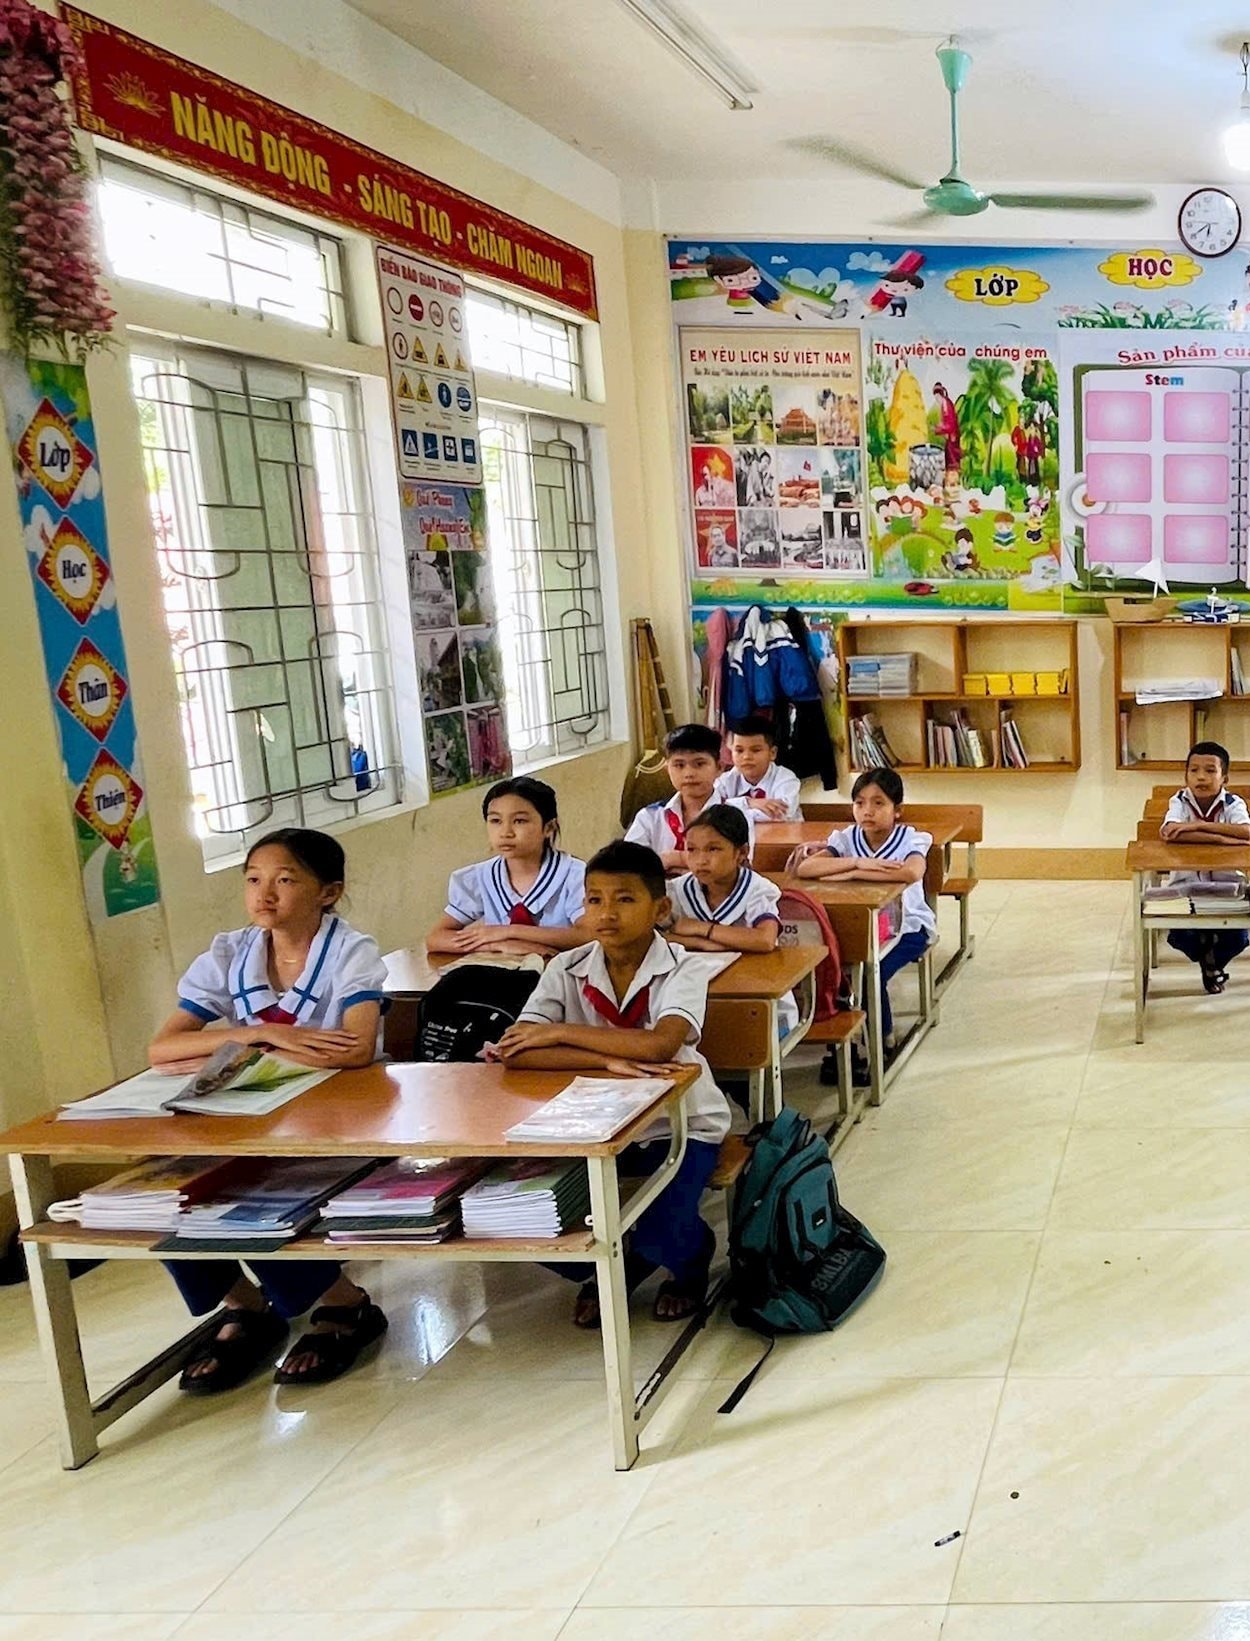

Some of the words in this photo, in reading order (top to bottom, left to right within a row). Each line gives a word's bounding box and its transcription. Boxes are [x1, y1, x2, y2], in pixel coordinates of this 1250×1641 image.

[170, 91, 256, 164] NĂNG
[262, 132, 332, 196] ĐỘNG
[359, 172, 413, 227] SÁNG
[417, 201, 452, 248] TẠO
[466, 222, 514, 267] CHĂM
[515, 243, 563, 290] NGOAN
[975, 273, 1019, 297] LỚP
[1128, 258, 1173, 280] HỌC
[690, 349, 707, 362] EM
[712, 345, 736, 362] YÊU
[773, 346, 789, 364] SỬ
[825, 352, 851, 364] NAM
[874, 343, 901, 356] Thư
[975, 344, 1020, 360] chúng
[1024, 348, 1047, 358] em
[1117, 347, 1157, 364] Sản
[1162, 341, 1217, 361] phẩm
[1144, 374, 1184, 386] Stem
[62, 560, 87, 583] Học
